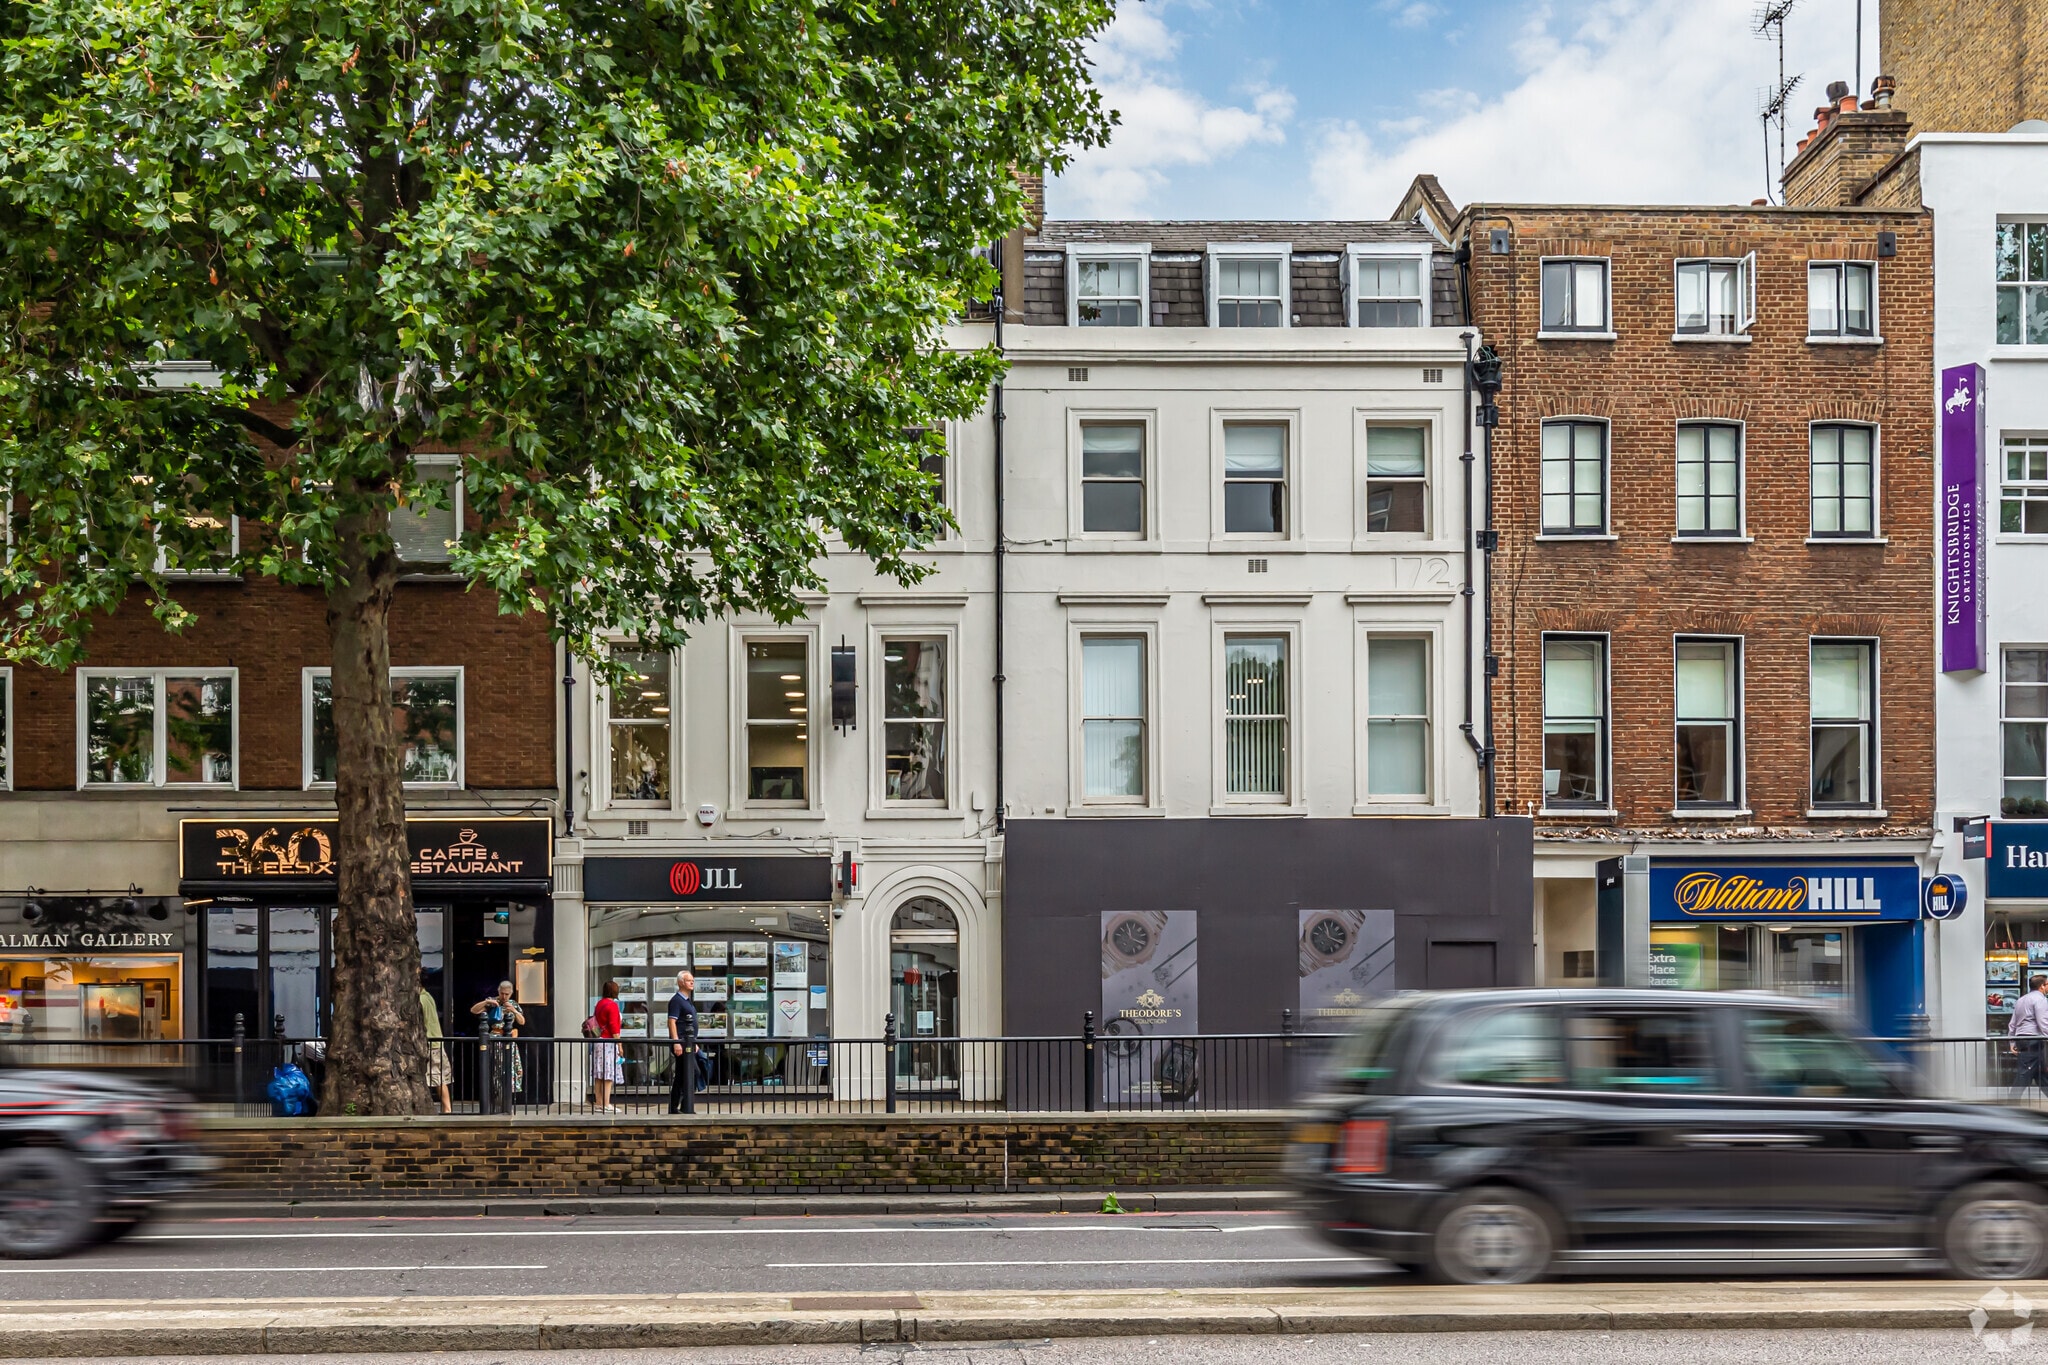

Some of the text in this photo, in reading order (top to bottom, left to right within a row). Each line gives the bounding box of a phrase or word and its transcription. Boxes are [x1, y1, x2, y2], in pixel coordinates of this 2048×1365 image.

[1947, 484, 1960, 625] KNIGHTSBRIDGE
[1963, 502, 1971, 603] ORTHODONTICS
[1390, 557, 1455, 588] 172
[216, 827, 332, 864] 360
[419, 848, 500, 860] CAFFE &
[2006, 845, 2048, 868] Ha
[410, 861, 523, 873] ESTAURANT
[700, 868, 743, 890] JLL
[1673, 871, 1881, 915] William HILL
[1932, 895, 1949, 911] HILL
[80, 933, 173, 948] GALLERY
[1648, 953, 1677, 963] Extra
[1648, 964, 1676, 974] Place
[1648, 976, 1679, 986] Races
[1119, 1009, 1182, 1018] THEODORE'S
